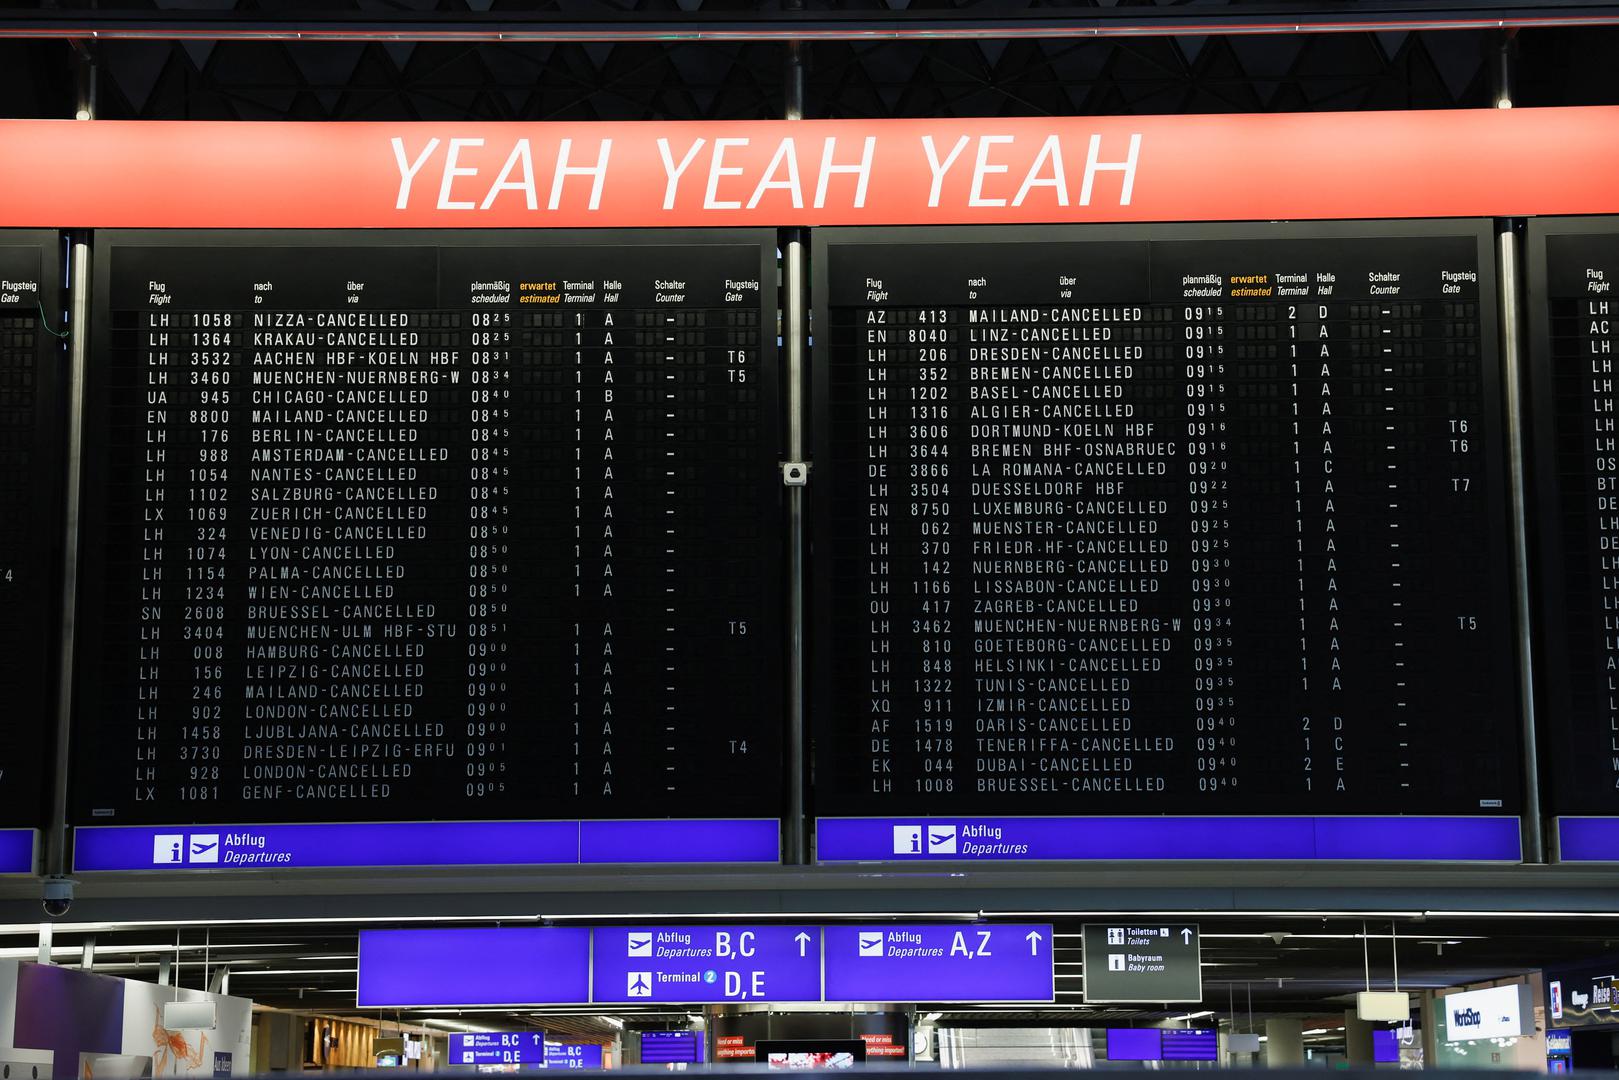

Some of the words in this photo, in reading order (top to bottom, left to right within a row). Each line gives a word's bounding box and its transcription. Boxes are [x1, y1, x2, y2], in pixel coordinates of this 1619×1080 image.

[390, 137, 612, 210] YEAH
[656, 136, 877, 210] YEAH
[921, 133, 1142, 208] YEAH
[968, 276, 987, 286] nach
[1059, 275, 1077, 286] über
[1182, 274, 1222, 286] planmäßig
[1230, 275, 1267, 284] erwartet
[1275, 272, 1308, 283] Terminal
[1316, 272, 1336, 283] Halle
[1368, 271, 1401, 282] Schalter
[1441, 270, 1477, 283] Flugsteig
[1586, 268, 1604, 281] Flug
[1, 280, 37, 293] Flugsteig
[149, 280, 166, 293] Flug
[253, 280, 273, 291] nach
[346, 280, 365, 291] über
[470, 280, 511, 293] planmäßig
[519, 281, 557, 291] erwartet
[562, 280, 595, 290] Terminal
[603, 280, 622, 290] Halle
[654, 279, 686, 290] Schalter
[725, 279, 759, 292] Flugsteig
[866, 277, 883, 291] Flug
[1230, 286, 1272, 297] estimated
[1277, 285, 1309, 295] Terminal
[1317, 285, 1333, 295] Hall
[1369, 284, 1400, 294] Counter
[1442, 283, 1461, 294] Gate
[1587, 281, 1610, 294] Flight
[0, 292, 20, 303] Gate
[148, 292, 172, 305] Flight
[254, 294, 263, 304] to
[347, 293, 359, 304] via
[471, 291, 511, 304] scheduled
[519, 293, 561, 304] estimated
[563, 292, 596, 303] Terminal
[603, 292, 620, 303] Hall
[655, 292, 686, 303] Counter
[724, 291, 743, 302] Gate
[866, 290, 889, 302] Flight
[968, 290, 977, 300] to
[1060, 288, 1072, 298] via
[1183, 287, 1222, 297] scheduled
[150, 313, 169, 327] LH
[193, 313, 232, 327] 1058
[254, 313, 408, 327] NIZZA-CANCELLED
[575, 313, 583, 327] 1
[604, 313, 614, 327] A
[866, 310, 886, 324] AZ
[918, 309, 947, 324] 413
[969, 307, 1141, 323] MAILAND-CANCELLED
[1288, 306, 1296, 320] 2
[1319, 305, 1328, 319] D
[254, 332, 418, 346] KRAKAU-CANCELLED
[970, 327, 1110, 342] LINZ-CANCELLED
[253, 351, 314, 366] AACHEN
[326, 351, 418, 365] HBF-KOELN
[430, 351, 458, 365] HBF
[727, 350, 746, 364] T6
[969, 346, 1142, 361] DRESDEN-CANCELLED
[252, 370, 459, 385] MUENCHEN-NUERNBERG-W
[727, 369, 746, 383] T5
[970, 365, 1132, 381] BREMEN-CANCELLED
[252, 390, 427, 404] CHICAGO-CANCELLED
[970, 384, 1122, 400] BASEL-CANCELLED
[252, 409, 427, 423] MAILAND-CANCELLED
[970, 404, 1133, 419] ALGIER-CANCELLED
[252, 428, 417, 443] BERLIN-CANCELLED
[970, 423, 1113, 438] DORTMUND-KOELN
[1125, 423, 1153, 437] HBF
[1448, 419, 1468, 434] T6
[251, 447, 447, 462] AMSTERDAM-CANCELLED
[971, 443, 1031, 458] BREMEN
[1043, 441, 1175, 457] BHF-OSNABRUEC
[1449, 439, 1469, 453] T6
[251, 467, 416, 482] NANTES-CANCELLED
[972, 463, 990, 477] LA
[1002, 461, 1165, 477] ROMANA-CANCELLED
[250, 486, 437, 502] SALZBURG-CANCELLED
[971, 481, 1082, 496] DUESSELDORF
[1095, 481, 1123, 495] HBF
[1451, 478, 1470, 492] T7
[250, 506, 426, 521] ZUERICH-CANCELLED
[973, 500, 1166, 516] LUXEMBURG-CANCELLED
[249, 525, 425, 541] VENEDIG-CANCELLED
[972, 520, 1157, 535] MUENSTER-CANCELLED
[143, 547, 163, 561] LH
[187, 546, 226, 561] 1074
[249, 545, 394, 560] LYON-CANCELLED
[973, 539, 1167, 555] FRIEDR.HF-CANCELLED
[248, 565, 404, 580] PALMA-CANCELLED
[973, 559, 1168, 574] NUERNBERG-CANCELLED
[248, 584, 393, 600] WIEN-CANCELLED
[974, 578, 1158, 594] LISSABON-CANCELLED
[247, 604, 434, 619] BRUESSEL-CANCELLED
[974, 598, 1137, 614] ZAGREB-CANCELLED
[247, 624, 371, 639] MUENCHEN-ULM
[384, 623, 455, 638] HBF-STU
[728, 621, 747, 636] T5
[974, 617, 1180, 633] MUENCHEN-NUERNBERG-W
[1457, 616, 1477, 631] T5
[246, 643, 423, 659] HAMBURG-CANCELLED
[974, 637, 1170, 653] GOETEBORG-CANCELLED
[246, 663, 423, 679] LEIPZIG-CANCELLED
[974, 657, 1160, 673] HELSINKI-CANCELLED
[245, 683, 422, 699] MAILAND-CANCELLED
[975, 677, 1129, 693] TUNIS-CANCELLED
[245, 703, 412, 719] LONDON-CANCELLED
[978, 697, 1130, 713] IZMIR-CANCELLED
[244, 722, 443, 739] LJUBLJANA-CANCELLED
[975, 717, 1130, 733] OARIS-CANCELLED
[243, 743, 454, 759] DRESDEN-LEIPZIG-ERFU
[728, 740, 748, 754] T4
[976, 737, 1173, 753] TENERIFFA-CANCELLED
[243, 763, 411, 780] LONDON-CANCELLED
[976, 757, 1131, 772] DUBAI-CANCELLED
[135, 786, 155, 801] LX
[180, 786, 218, 801] 1081
[242, 783, 389, 800] GENF-CANCELLED
[872, 778, 892, 793] LH
[915, 778, 954, 793] 1008
[977, 777, 1164, 792] BRUESSEL-CANCELLED
[961, 824, 1002, 840] Abflug
[224, 833, 266, 849] Abflug
[962, 841, 1029, 858] Departures
[223, 850, 292, 867] Departures
[1126, 927, 1158, 936] Toiletten
[656, 931, 691, 945] Abflug
[715, 931, 755, 961] B,C
[887, 931, 922, 945] Abflug
[949, 931, 992, 961] A,Z
[1126, 937, 1150, 946] Toilets
[656, 946, 713, 960] Departures
[887, 945, 944, 960] Departures
[1127, 953, 1163, 964] Babyraum
[1128, 964, 1146, 974] Baby
[1147, 964, 1165, 973] room
[656, 971, 701, 983] Terminal
[706, 972, 715, 983] 2
[724, 971, 766, 1000] D,E
[501, 1034, 520, 1048] B,C
[503, 1050, 521, 1063] D,E
